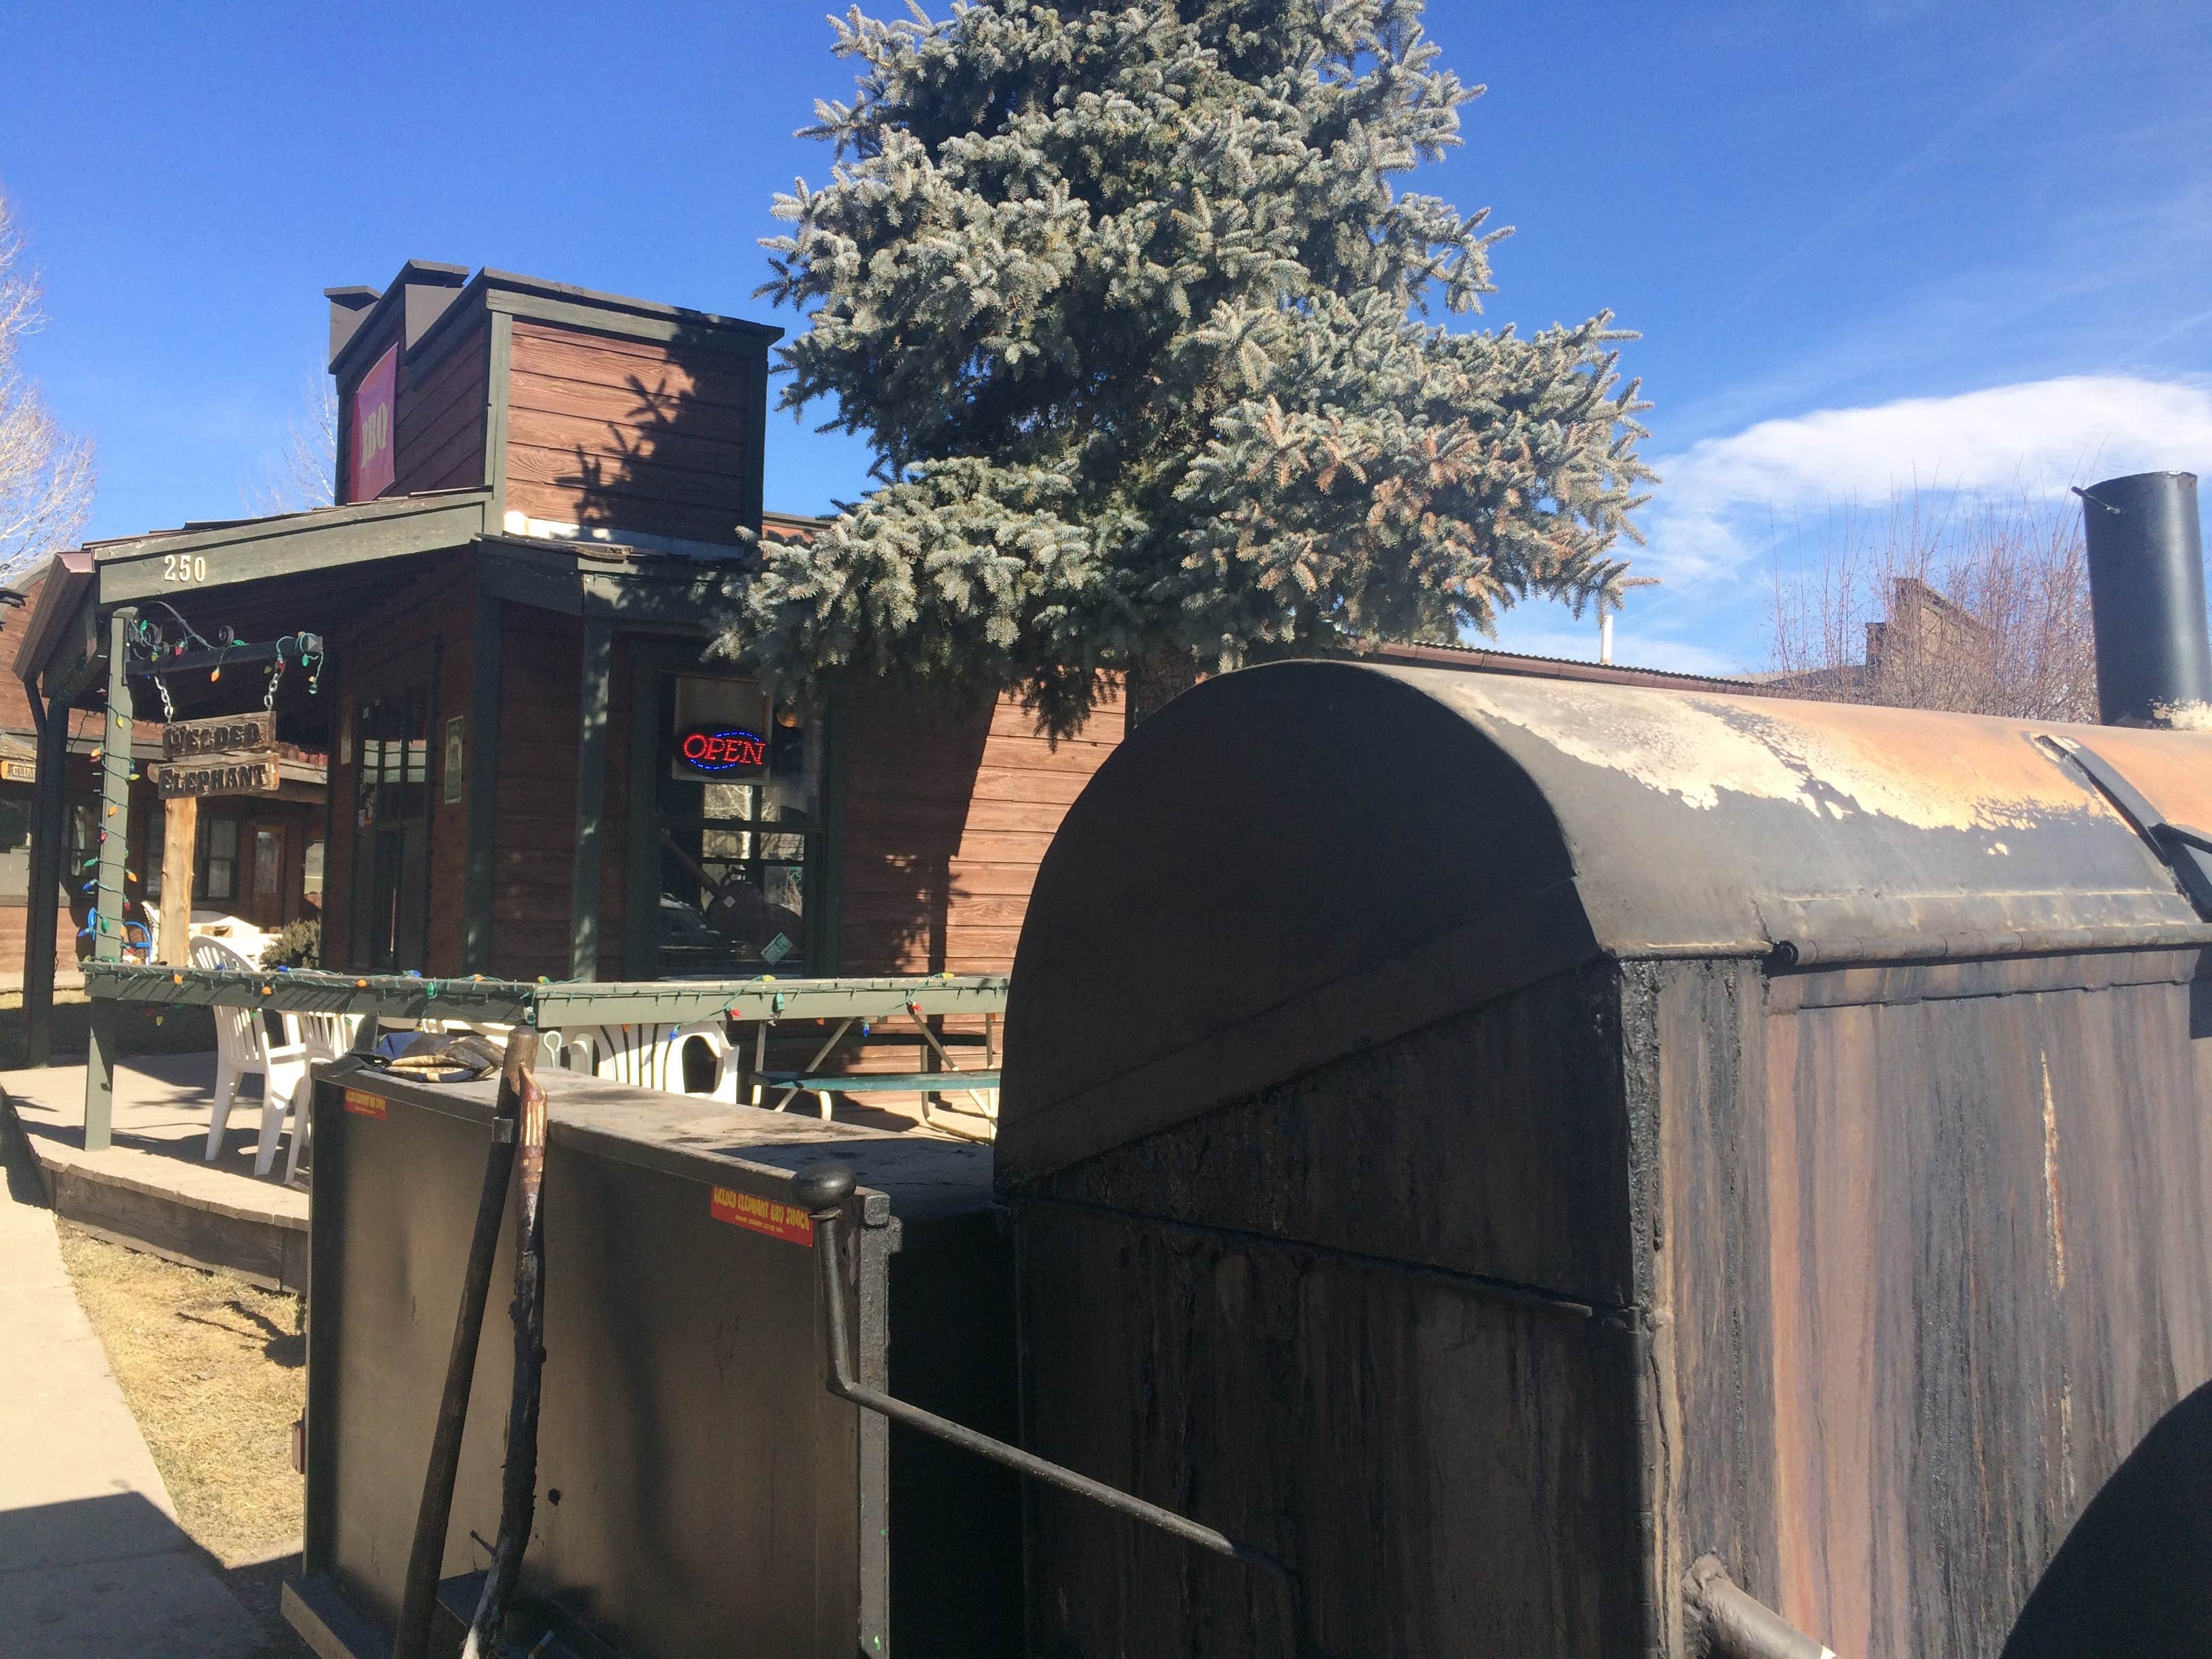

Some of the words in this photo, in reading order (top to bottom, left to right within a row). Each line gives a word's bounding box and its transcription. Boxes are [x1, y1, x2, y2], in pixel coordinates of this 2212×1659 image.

[361, 402, 388, 469] BBQ
[164, 554, 206, 582] 250
[683, 733, 766, 765] OPEN
[159, 764, 266, 796] ELEPHANT
